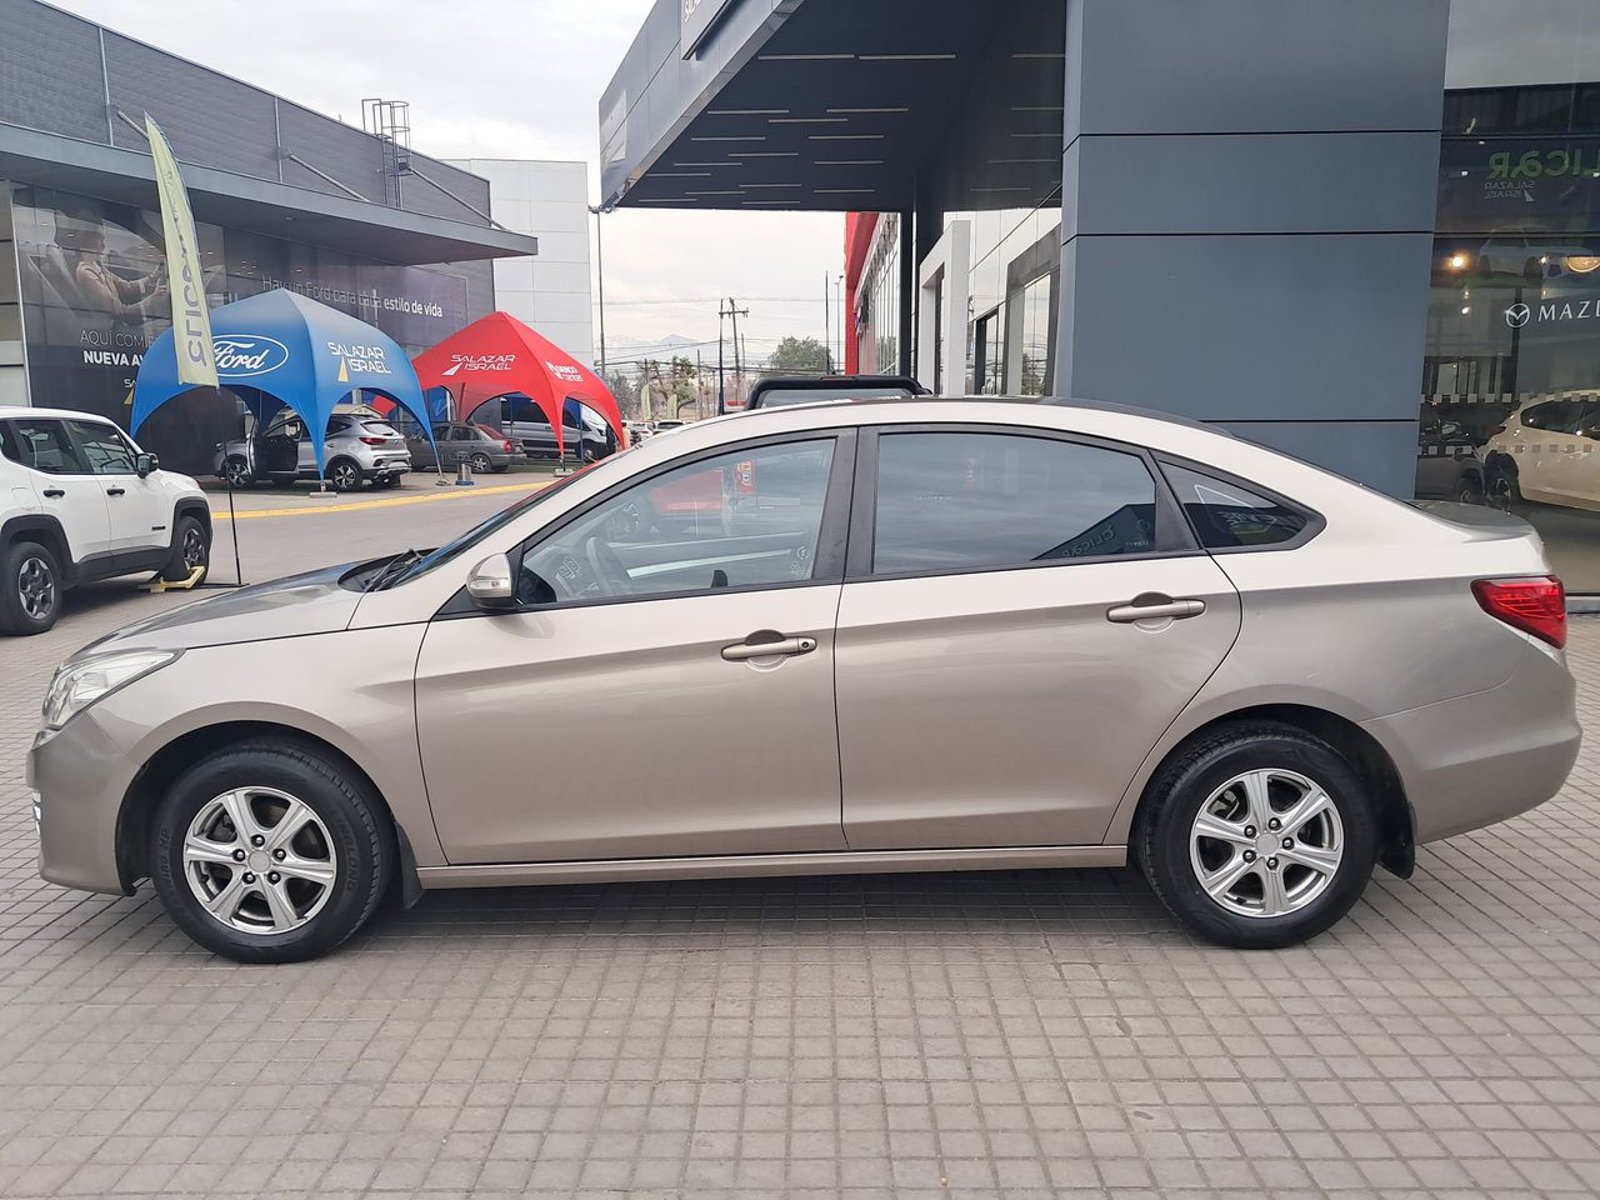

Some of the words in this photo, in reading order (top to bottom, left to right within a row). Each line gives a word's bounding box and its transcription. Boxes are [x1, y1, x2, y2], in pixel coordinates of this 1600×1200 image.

[333, 289, 356, 305] para
[358, 290, 382, 308] cada
[383, 297, 410, 312] estilo
[411, 300, 423, 315] de
[424, 303, 443, 318] vida
[83, 350, 129, 366] NUEVA
[213, 340, 269, 370] Ford
[327, 342, 386, 360] SALAZAR
[451, 354, 515, 362] SALAZAR
[348, 358, 391, 374] ISRAEL
[464, 363, 512, 371] ISRAEL
